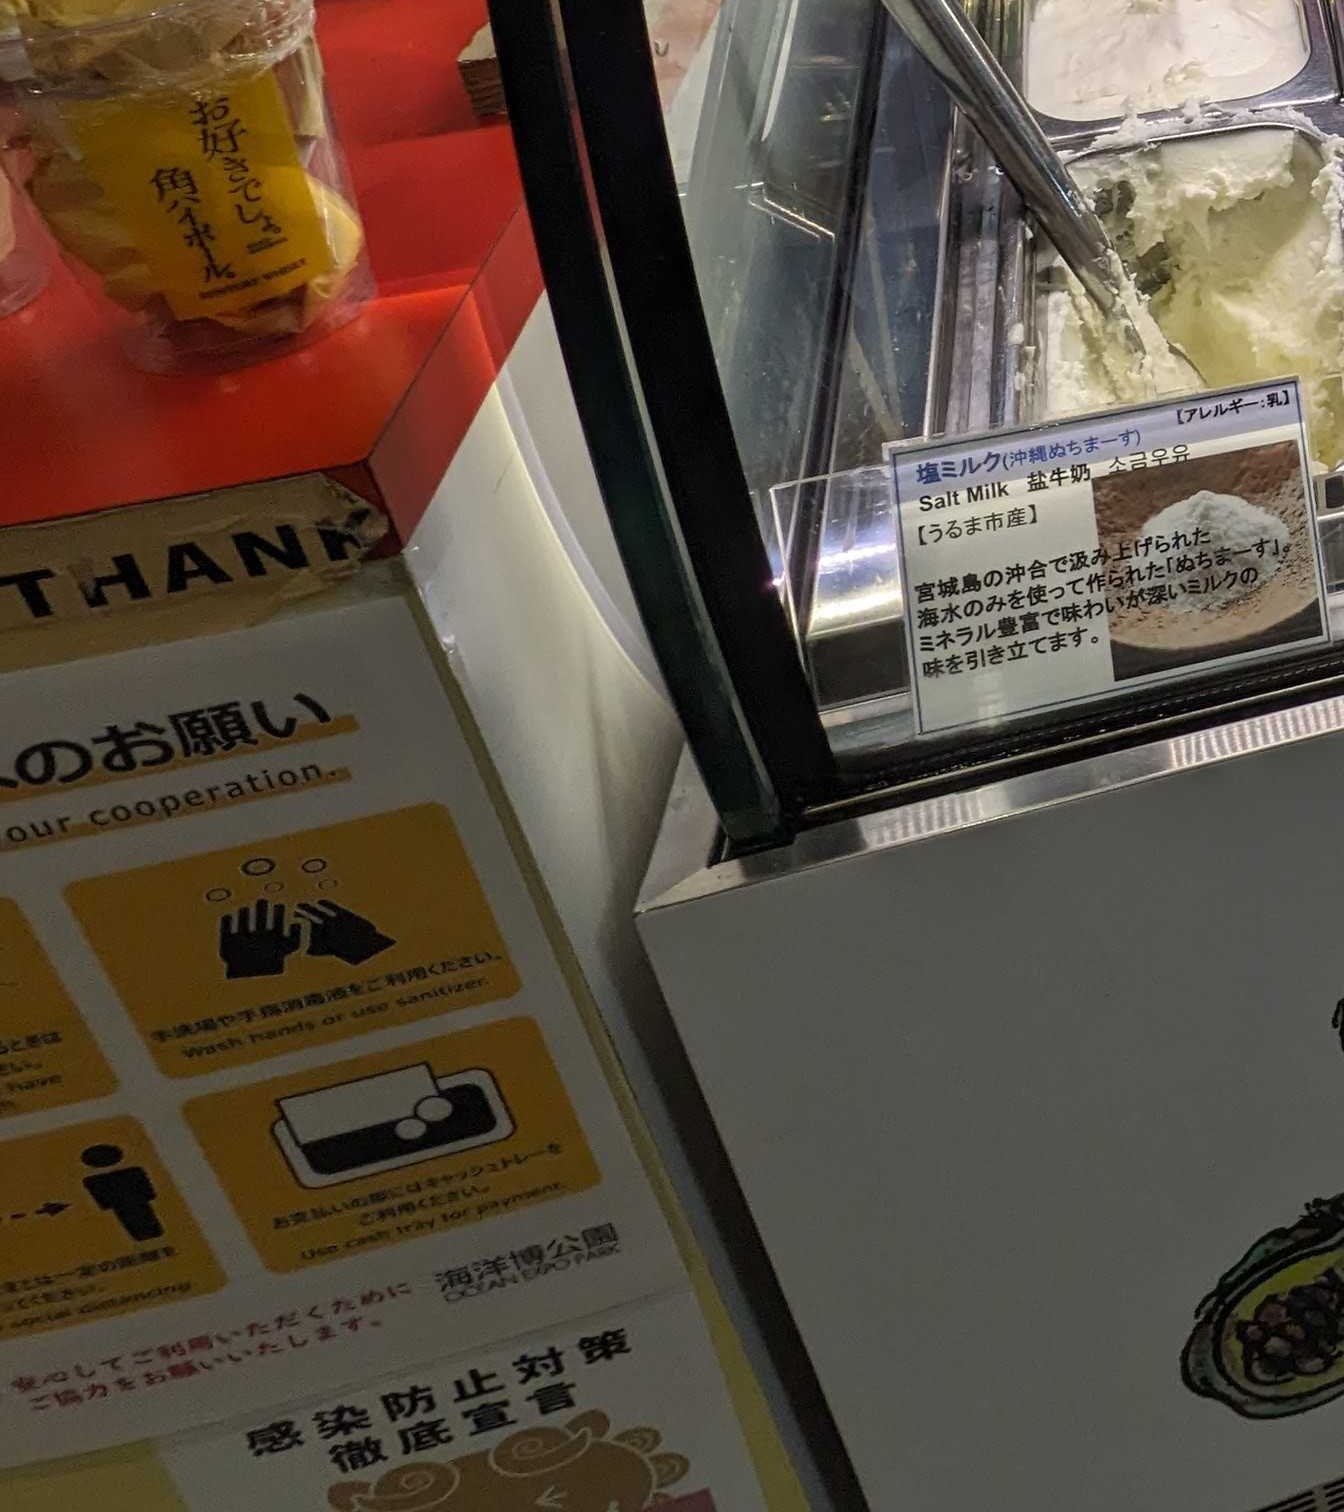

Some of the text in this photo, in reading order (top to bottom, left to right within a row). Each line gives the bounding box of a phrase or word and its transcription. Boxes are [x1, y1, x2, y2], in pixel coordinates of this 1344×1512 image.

[918, 442, 1191, 513] Salt Milk 盐牛奶 소금우유
[918, 503, 1039, 546] 【うるま市産】
[913, 526, 1213, 605] 宮城島の沖合で汲み上げられた
[918, 566, 1259, 653] ミネラル豊富で味わいが深いミルクの
[921, 626, 1100, 680] 味を引き立てます。
[89, 761, 338, 828] cooperation.
[181, 976, 490, 1060] Wash hands or use sanitizer.
[396, 1215, 437, 1237] tray
[440, 1205, 468, 1223] for
[434, 1221, 620, 1293] 海洋博公園
[245, 1327, 633, 1458] 感染防止対策
[328, 1381, 578, 1475] 徹底宣言
